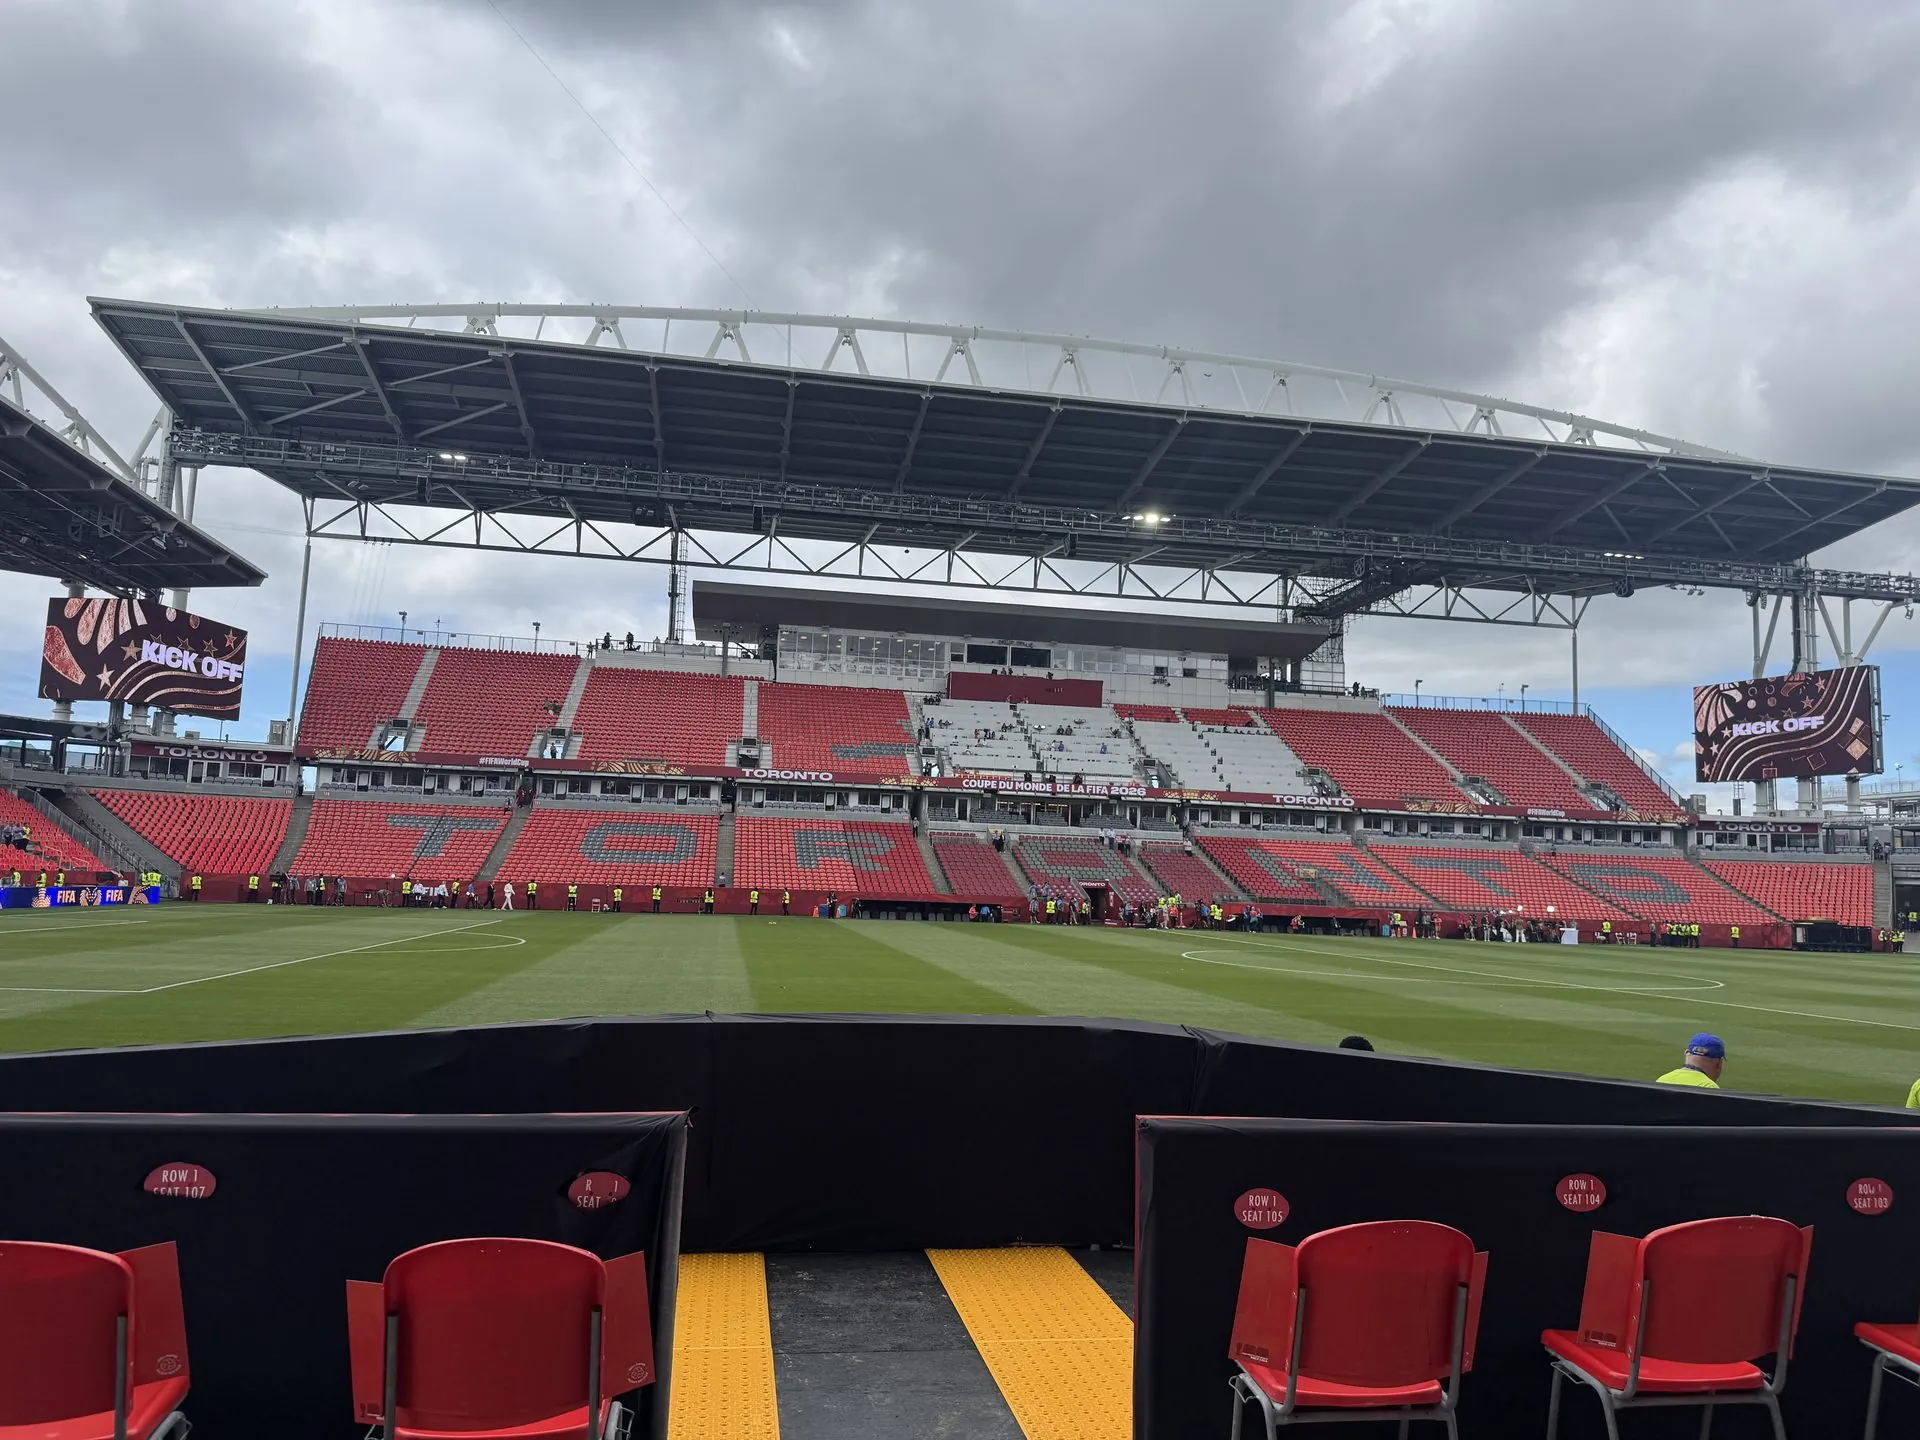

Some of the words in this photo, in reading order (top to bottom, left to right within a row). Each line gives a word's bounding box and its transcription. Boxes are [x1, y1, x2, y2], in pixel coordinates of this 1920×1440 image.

[141, 639, 199, 673] KICK
[201, 656, 244, 682] OFF
[1732, 719, 1781, 736] KICK
[1782, 715, 1825, 733] OFF
[154, 745, 268, 762] TORONTO
[479, 756, 530, 768] #FIFAWorldCup
[741, 768, 833, 781] TORONTO
[962, 778, 998, 789] COUPE
[999, 780, 1014, 790] DU
[1015, 781, 1052, 792] MONDE
[1056, 783, 1070, 793] DE
[1071, 784, 1085, 793] LA
[1086, 785, 1109, 795] FIFA
[1110, 786, 1147, 796] 2026
[1272, 794, 1355, 807] TORONTO
[1715, 821, 1802, 832] TORONTO
[57, 890, 76, 904] FIFA
[105, 889, 124, 902] FIFA
[162, 1169, 188, 1183] ROW
[194, 1168, 199, 1182] 1
[1568, 1179, 1587, 1191] ROW
[1858, 1183, 1876, 1195] ROW
[185, 1186, 205, 1199] 107
[1563, 1193, 1582, 1205] SEAT
[1585, 1193, 1600, 1205] 104
[577, 1195, 601, 1209] SEAT
[1249, 1195, 1269, 1207] ROW
[1272, 1195, 1277, 1207] 1
[1853, 1197, 1872, 1209] SEAT
[1873, 1197, 1889, 1209] 103
[1242, 1210, 1263, 1222] SEAT
[1267, 1210, 1283, 1223] 105
